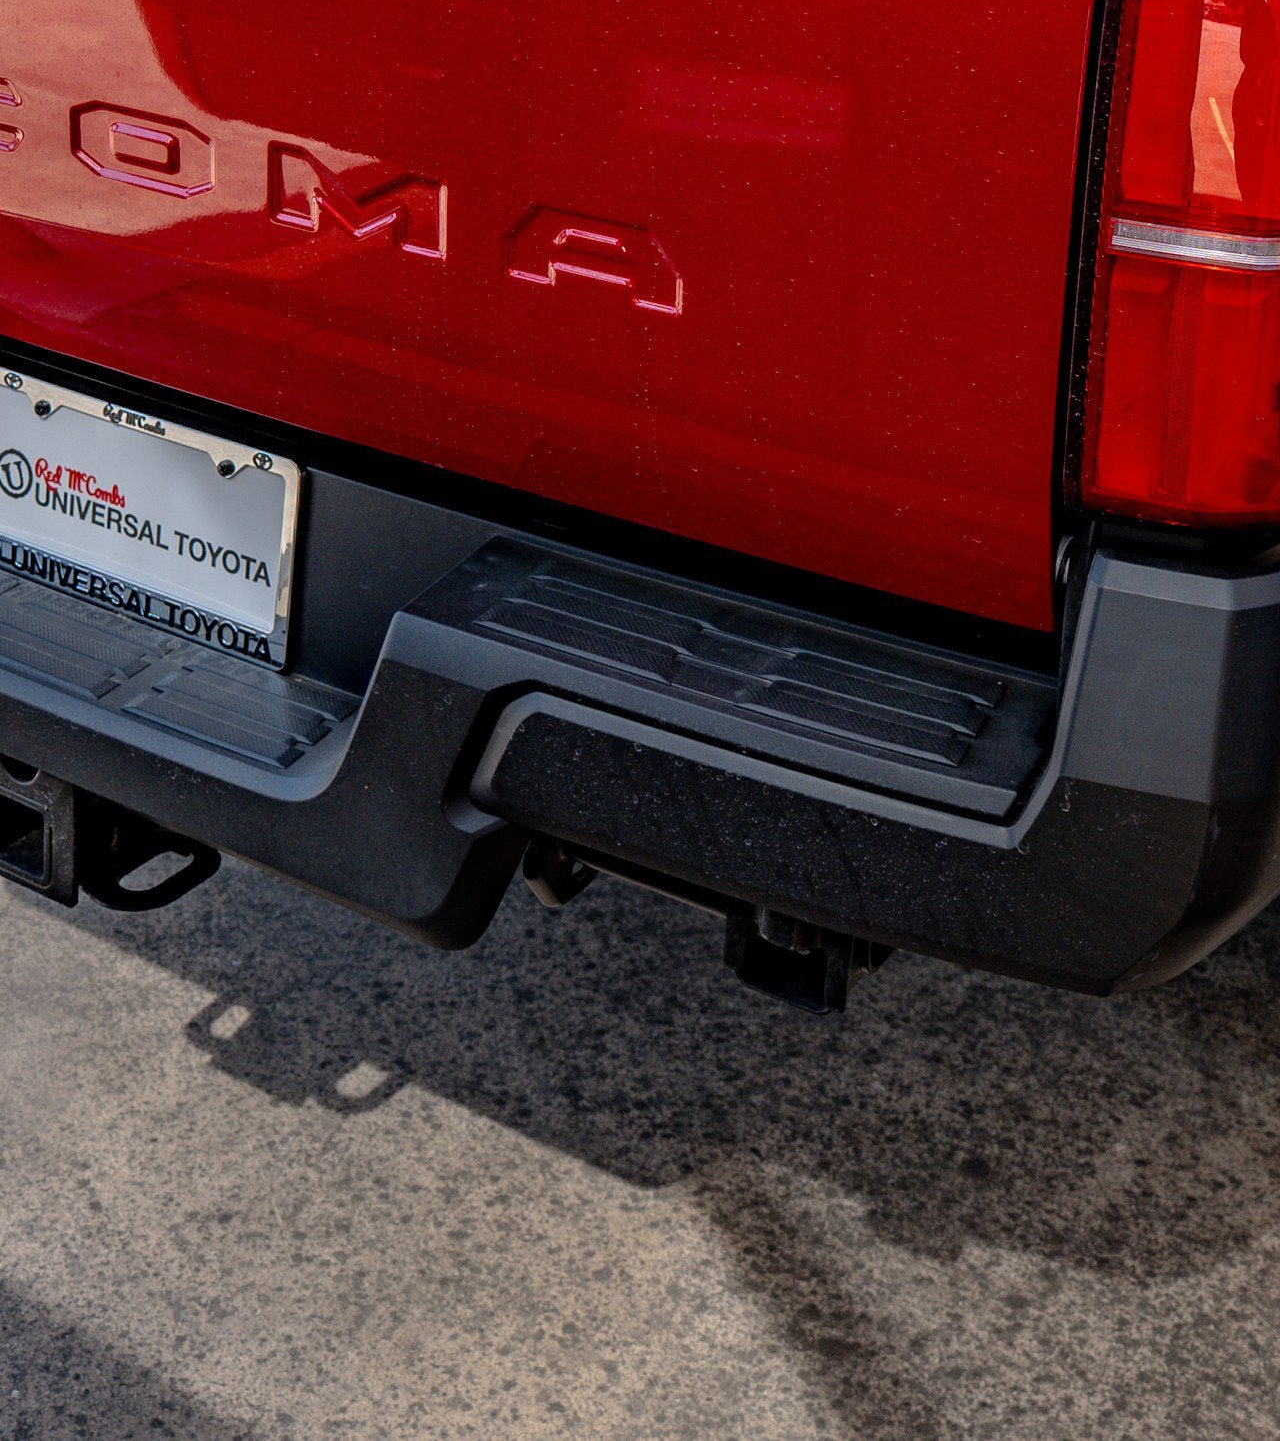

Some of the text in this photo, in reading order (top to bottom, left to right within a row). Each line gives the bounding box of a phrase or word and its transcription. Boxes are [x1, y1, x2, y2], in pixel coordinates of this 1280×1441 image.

[34, 458, 126, 508] Red McCombs
[34, 482, 272, 588] UNIVERSAL TOYOTA
[11, 542, 161, 620] UNIVERSAL
[163, 600, 272, 661] TOYOTA
